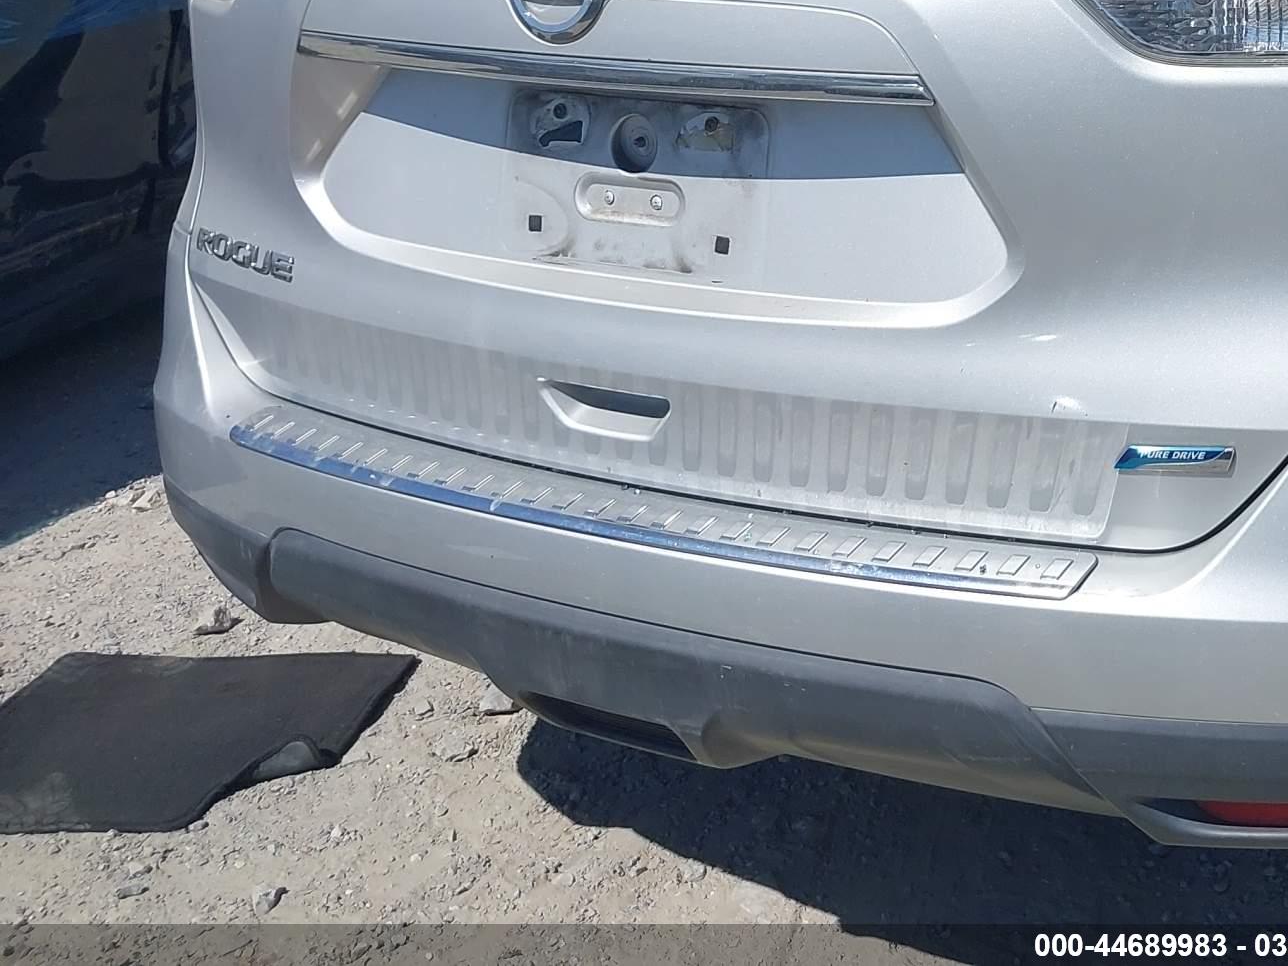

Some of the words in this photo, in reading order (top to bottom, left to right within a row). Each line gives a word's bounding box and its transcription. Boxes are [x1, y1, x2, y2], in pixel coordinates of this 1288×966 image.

[197, 227, 294, 283] ROGUE
[1139, 450, 1169, 459] PURE
[1171, 451, 1206, 460] DRIVE
